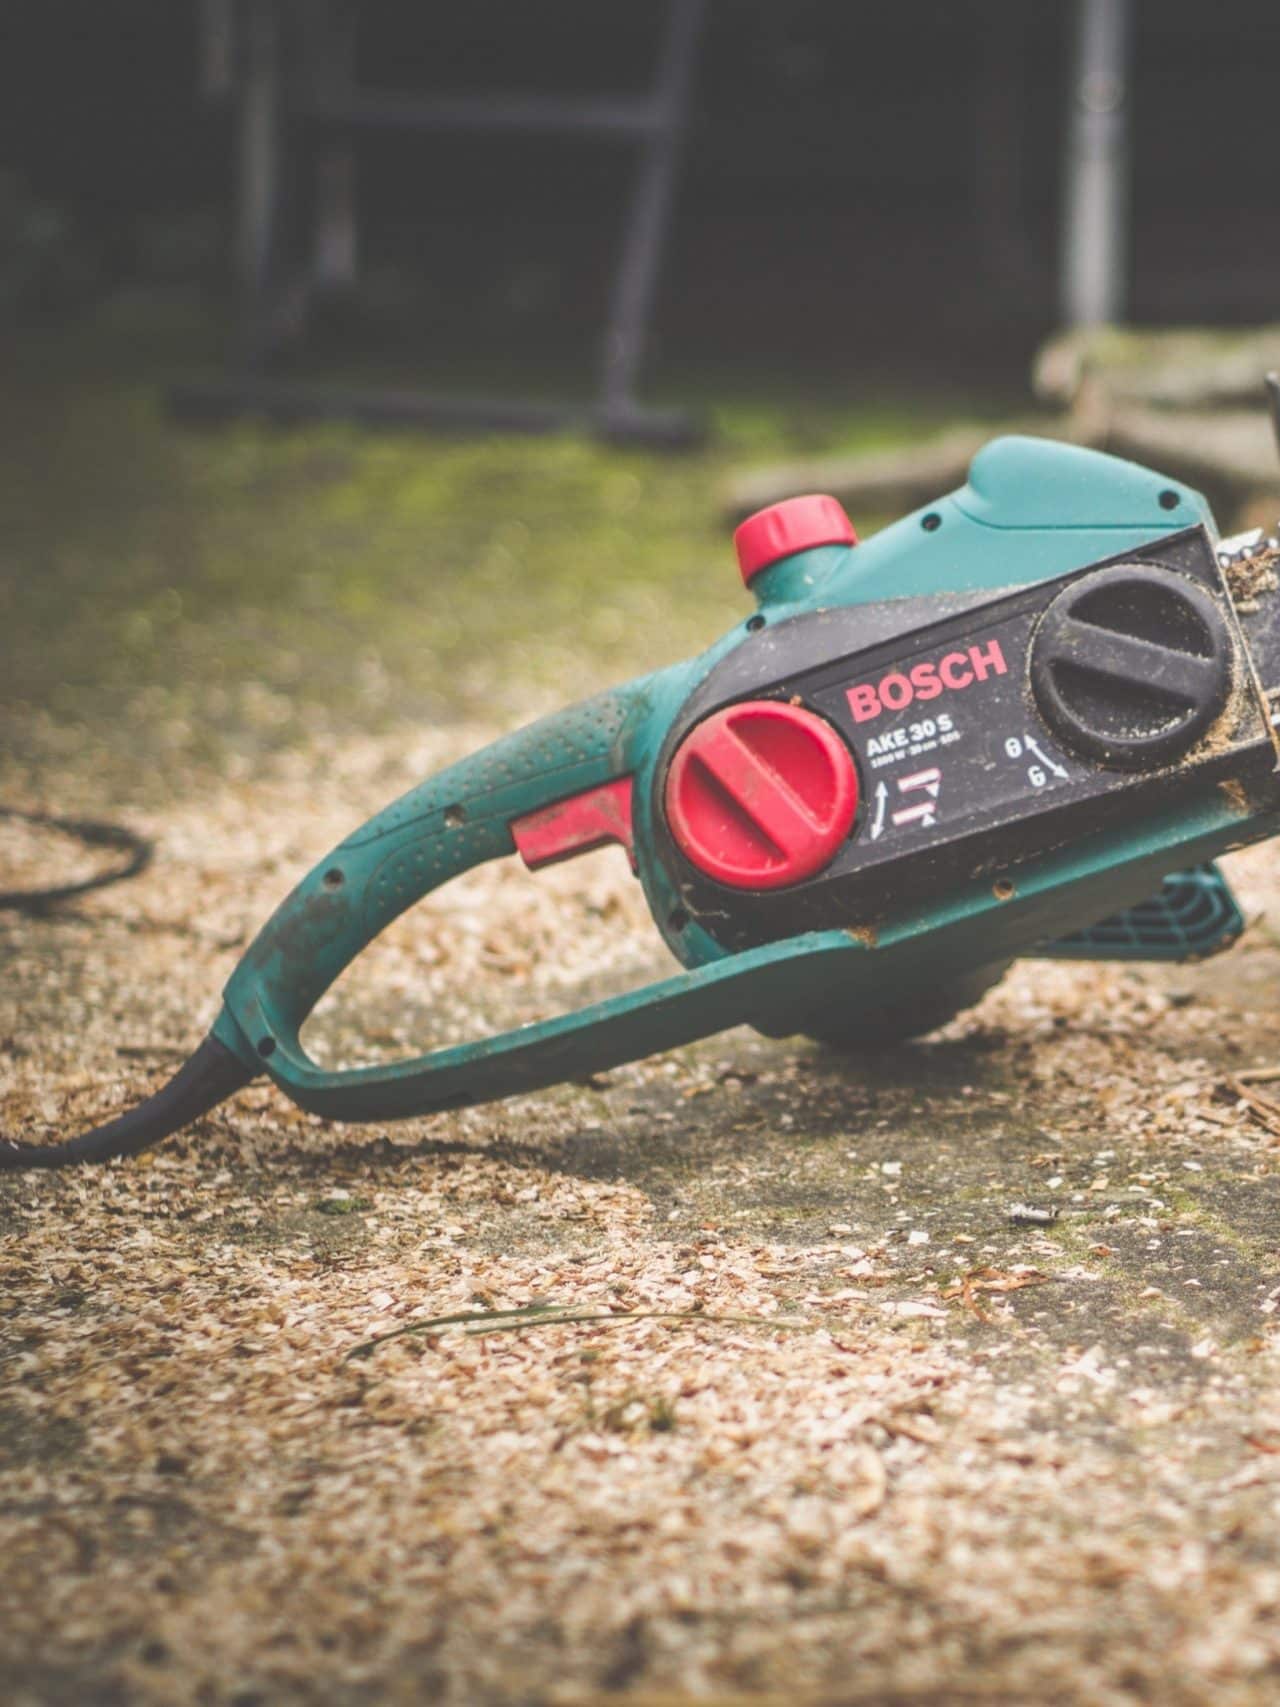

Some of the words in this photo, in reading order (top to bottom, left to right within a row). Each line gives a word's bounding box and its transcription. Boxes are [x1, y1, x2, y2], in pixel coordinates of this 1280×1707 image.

[845, 639, 1008, 723] BOSCH
[866, 728, 910, 757] AKE
[908, 718, 936, 741] 30
[936, 713, 953, 732] S
